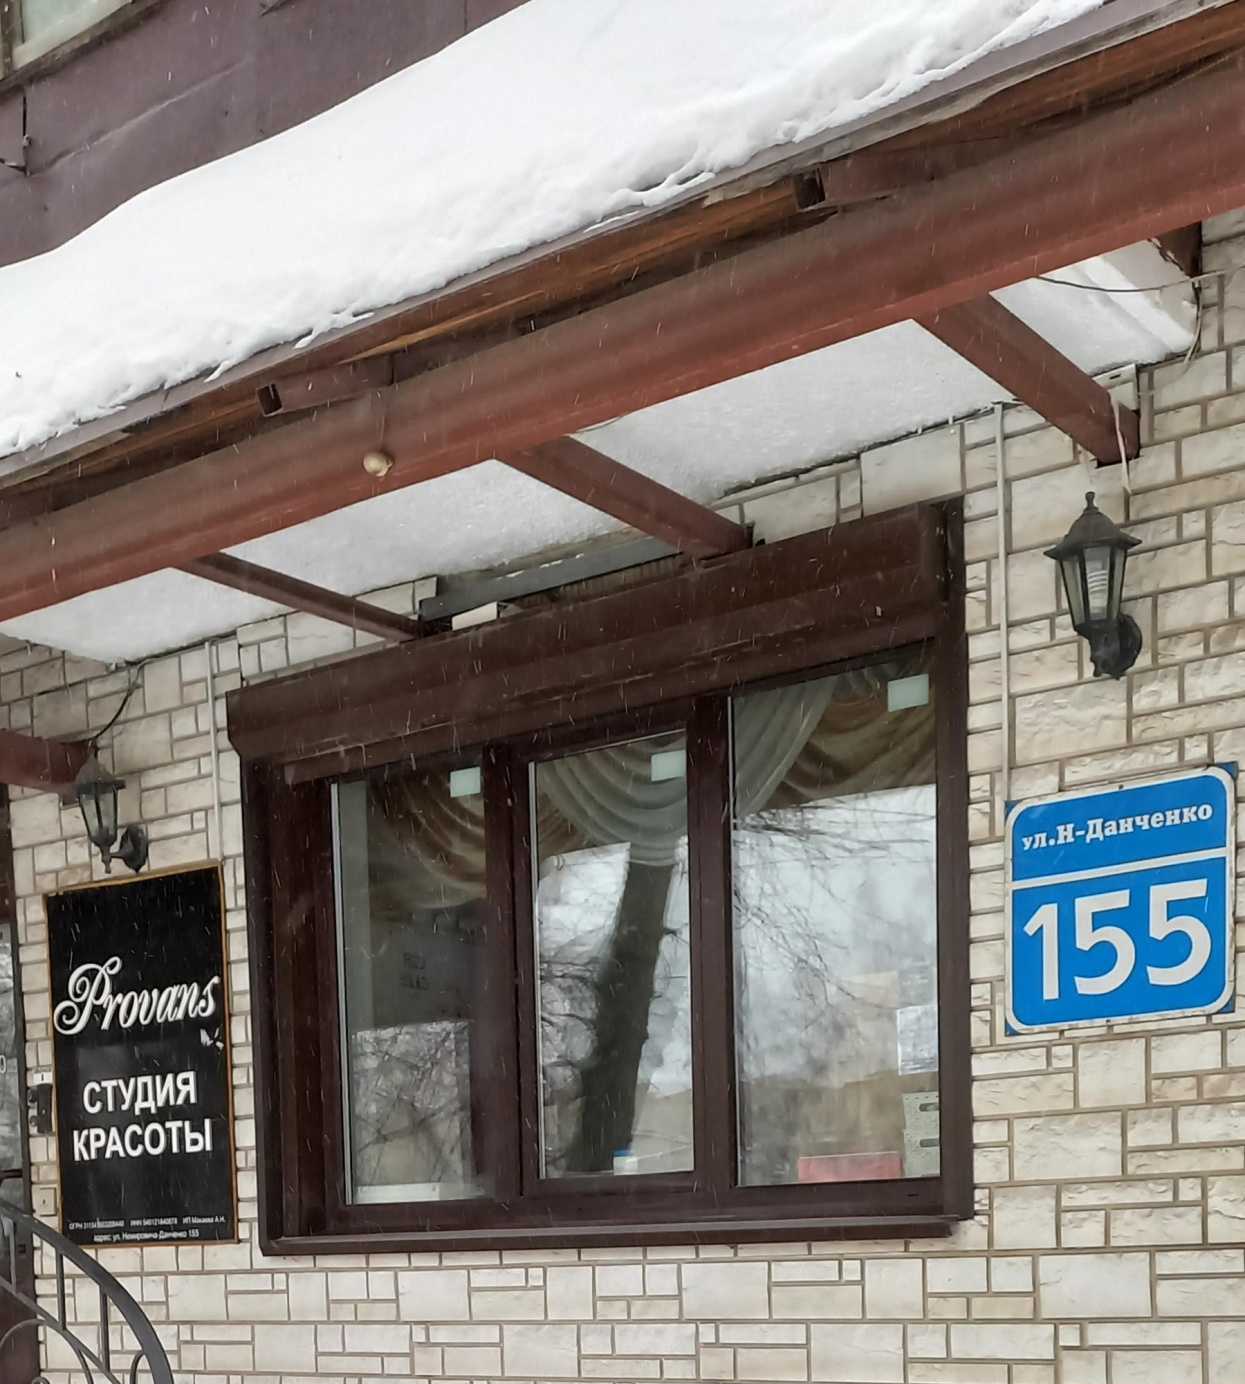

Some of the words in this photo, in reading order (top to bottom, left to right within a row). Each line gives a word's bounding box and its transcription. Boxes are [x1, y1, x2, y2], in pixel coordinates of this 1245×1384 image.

[1022, 803, 1213, 851] ул.Н-Данченко
[1023, 878, 1212, 1000] 155
[53, 956, 221, 1036] Provans
[83, 1070, 198, 1115] СТУДИЯ
[73, 1118, 213, 1162] КРАСОТЫ
[189, 1228, 199, 1238] 155
